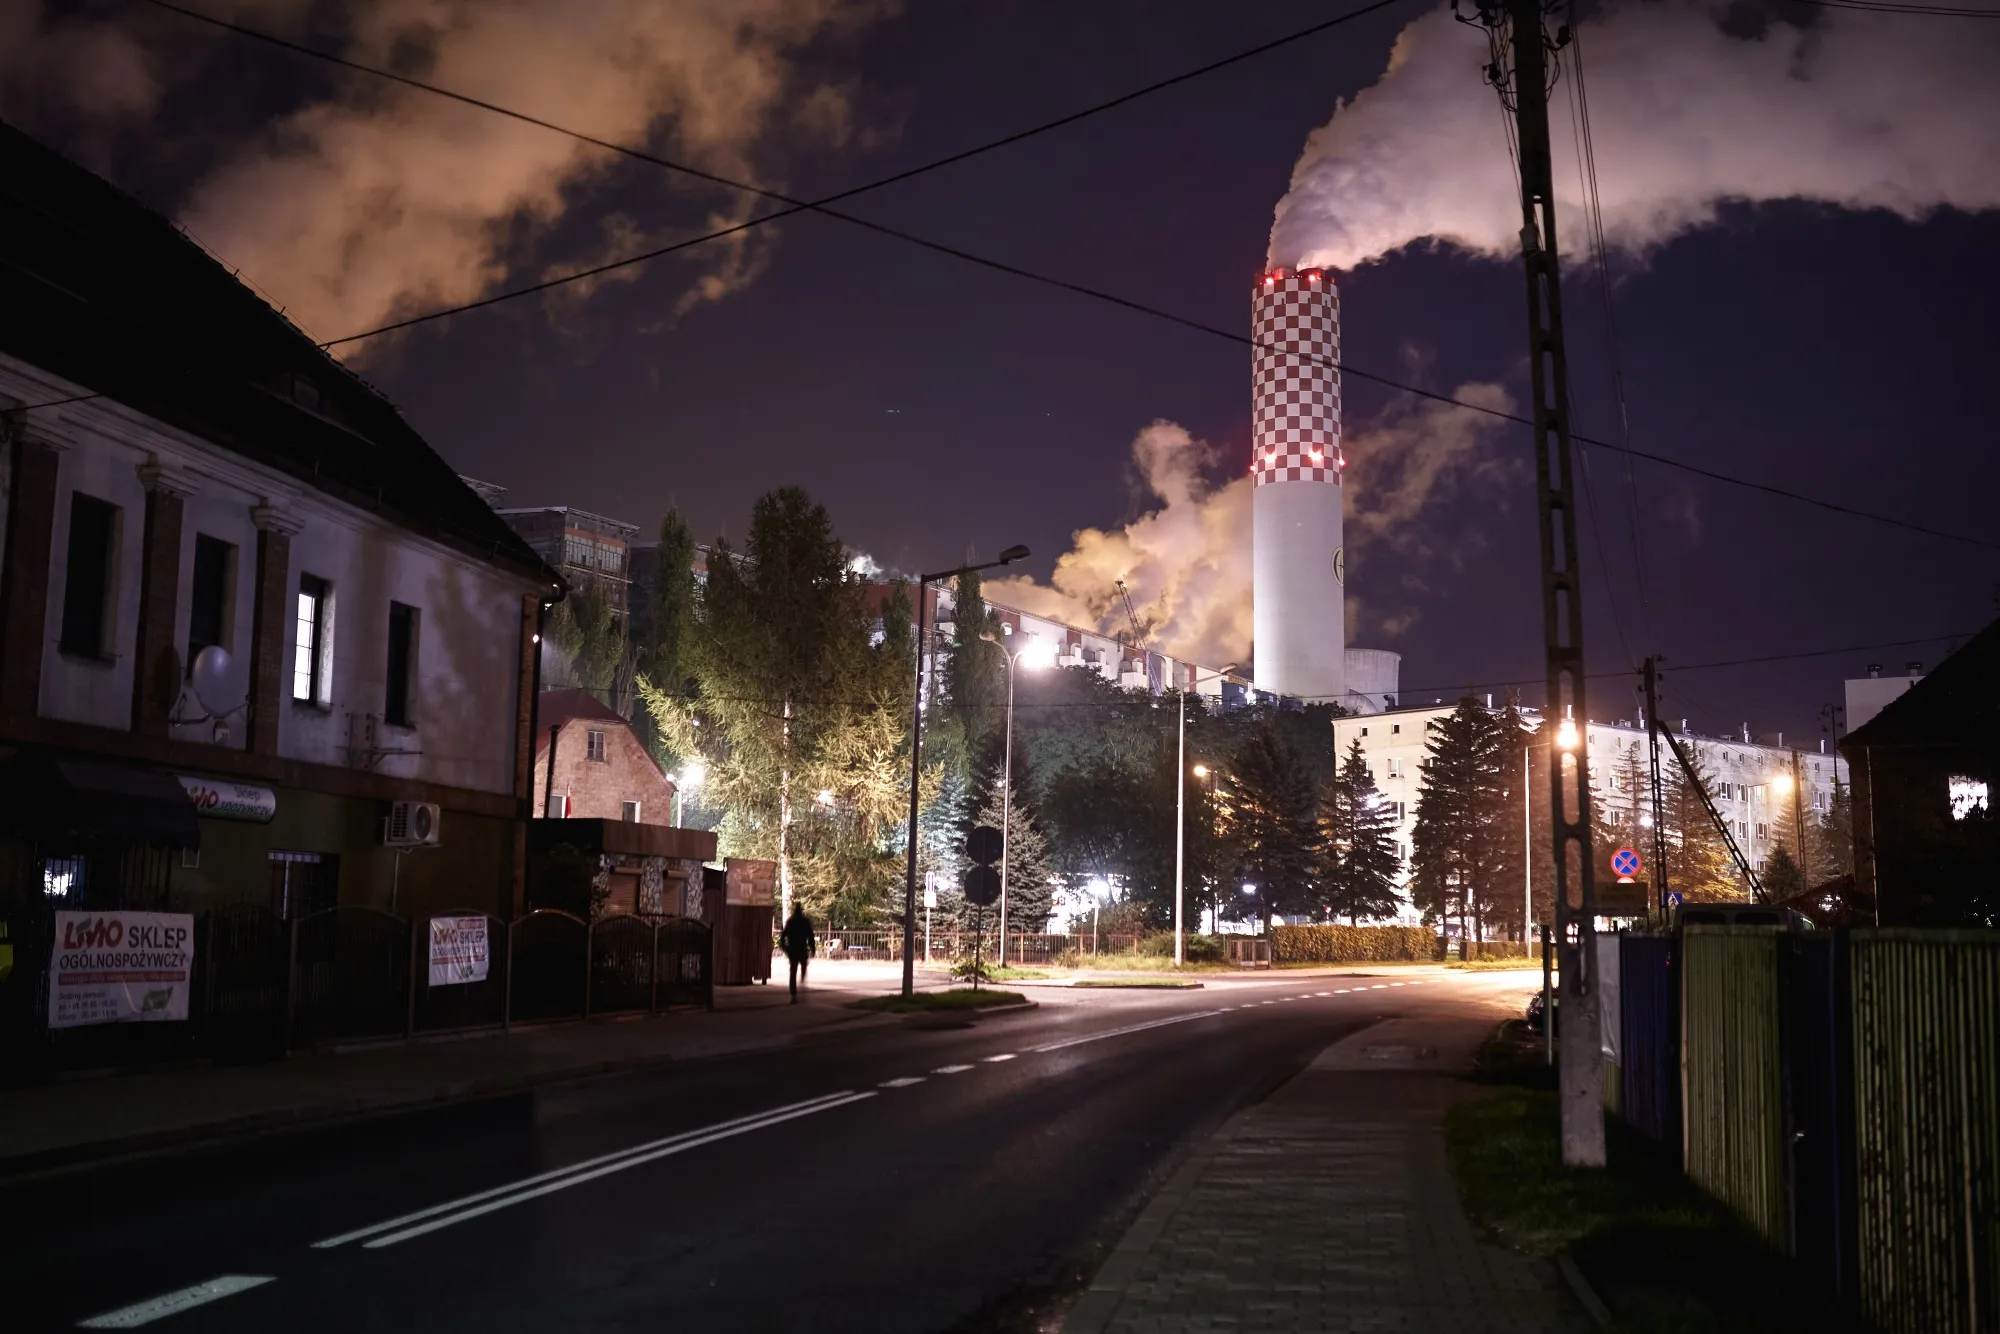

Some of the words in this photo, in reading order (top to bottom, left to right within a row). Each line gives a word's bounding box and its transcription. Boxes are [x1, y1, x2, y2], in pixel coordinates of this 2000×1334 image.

[234, 785, 261, 802] Sklep
[127, 925, 187, 949] SKLEP
[459, 930, 485, 944] SKLEP
[59, 950, 187, 970] OGÓLNOSPOŻYWCZY
